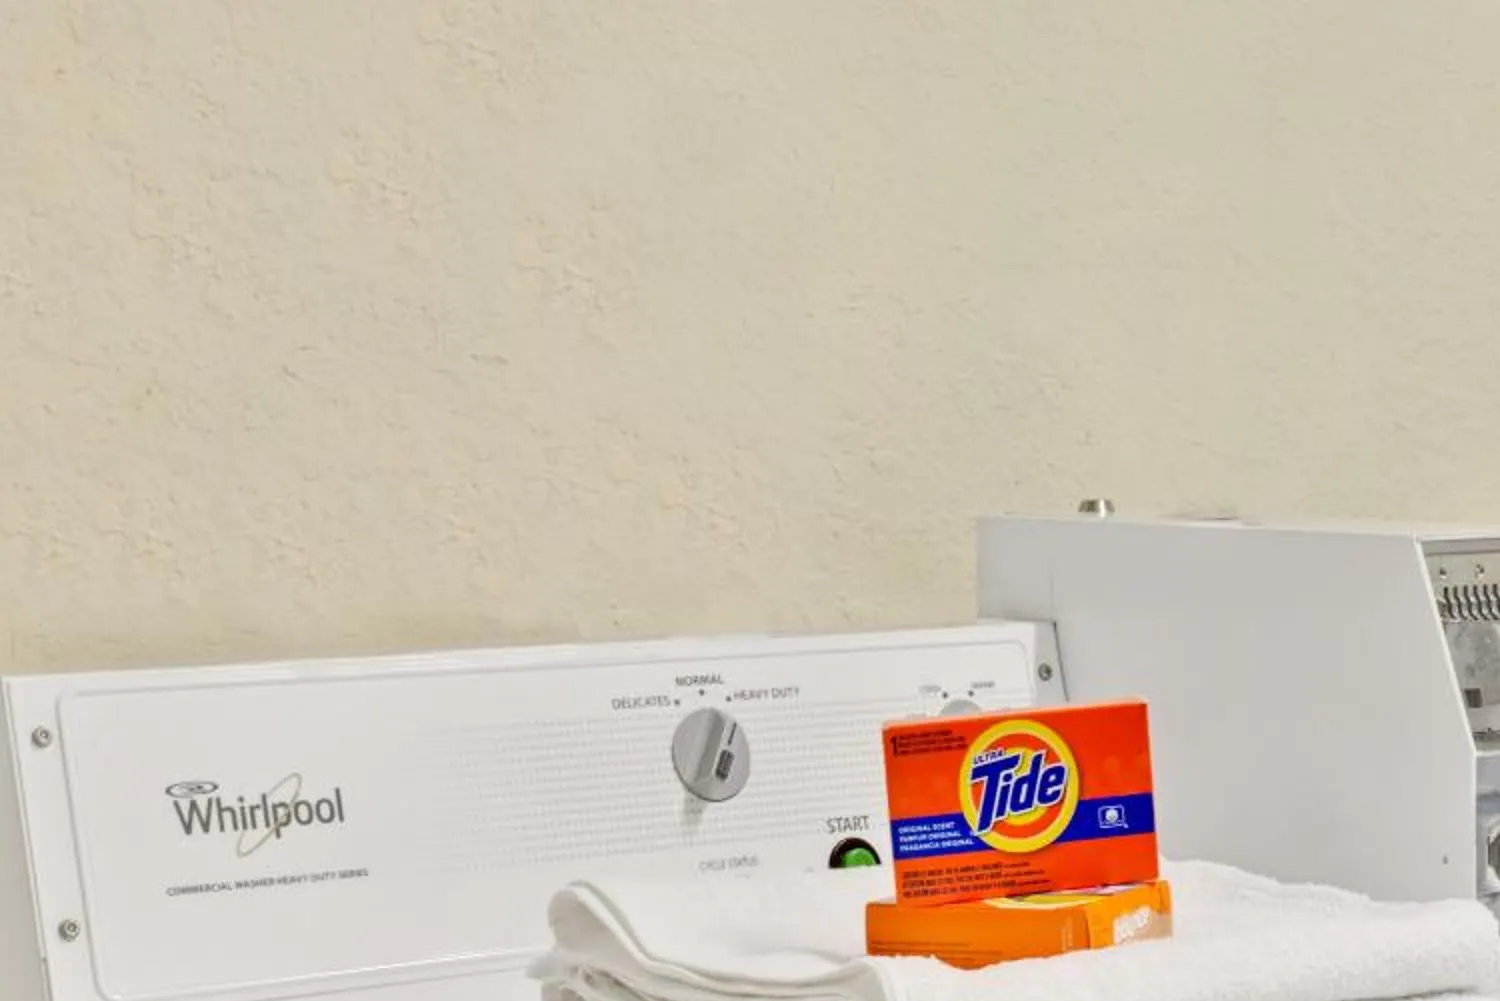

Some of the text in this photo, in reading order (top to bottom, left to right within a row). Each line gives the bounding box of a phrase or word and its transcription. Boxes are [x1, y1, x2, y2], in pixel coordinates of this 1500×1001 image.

[675, 673, 724, 687] NORMAL
[611, 695, 671, 710] DELICATES
[733, 687, 800, 701] HEAVY DUTY
[973, 747, 1005, 765] ULTRA
[970, 749, 1068, 835] Tide
[173, 786, 345, 839] Whirlpool
[826, 815, 870, 834] START
